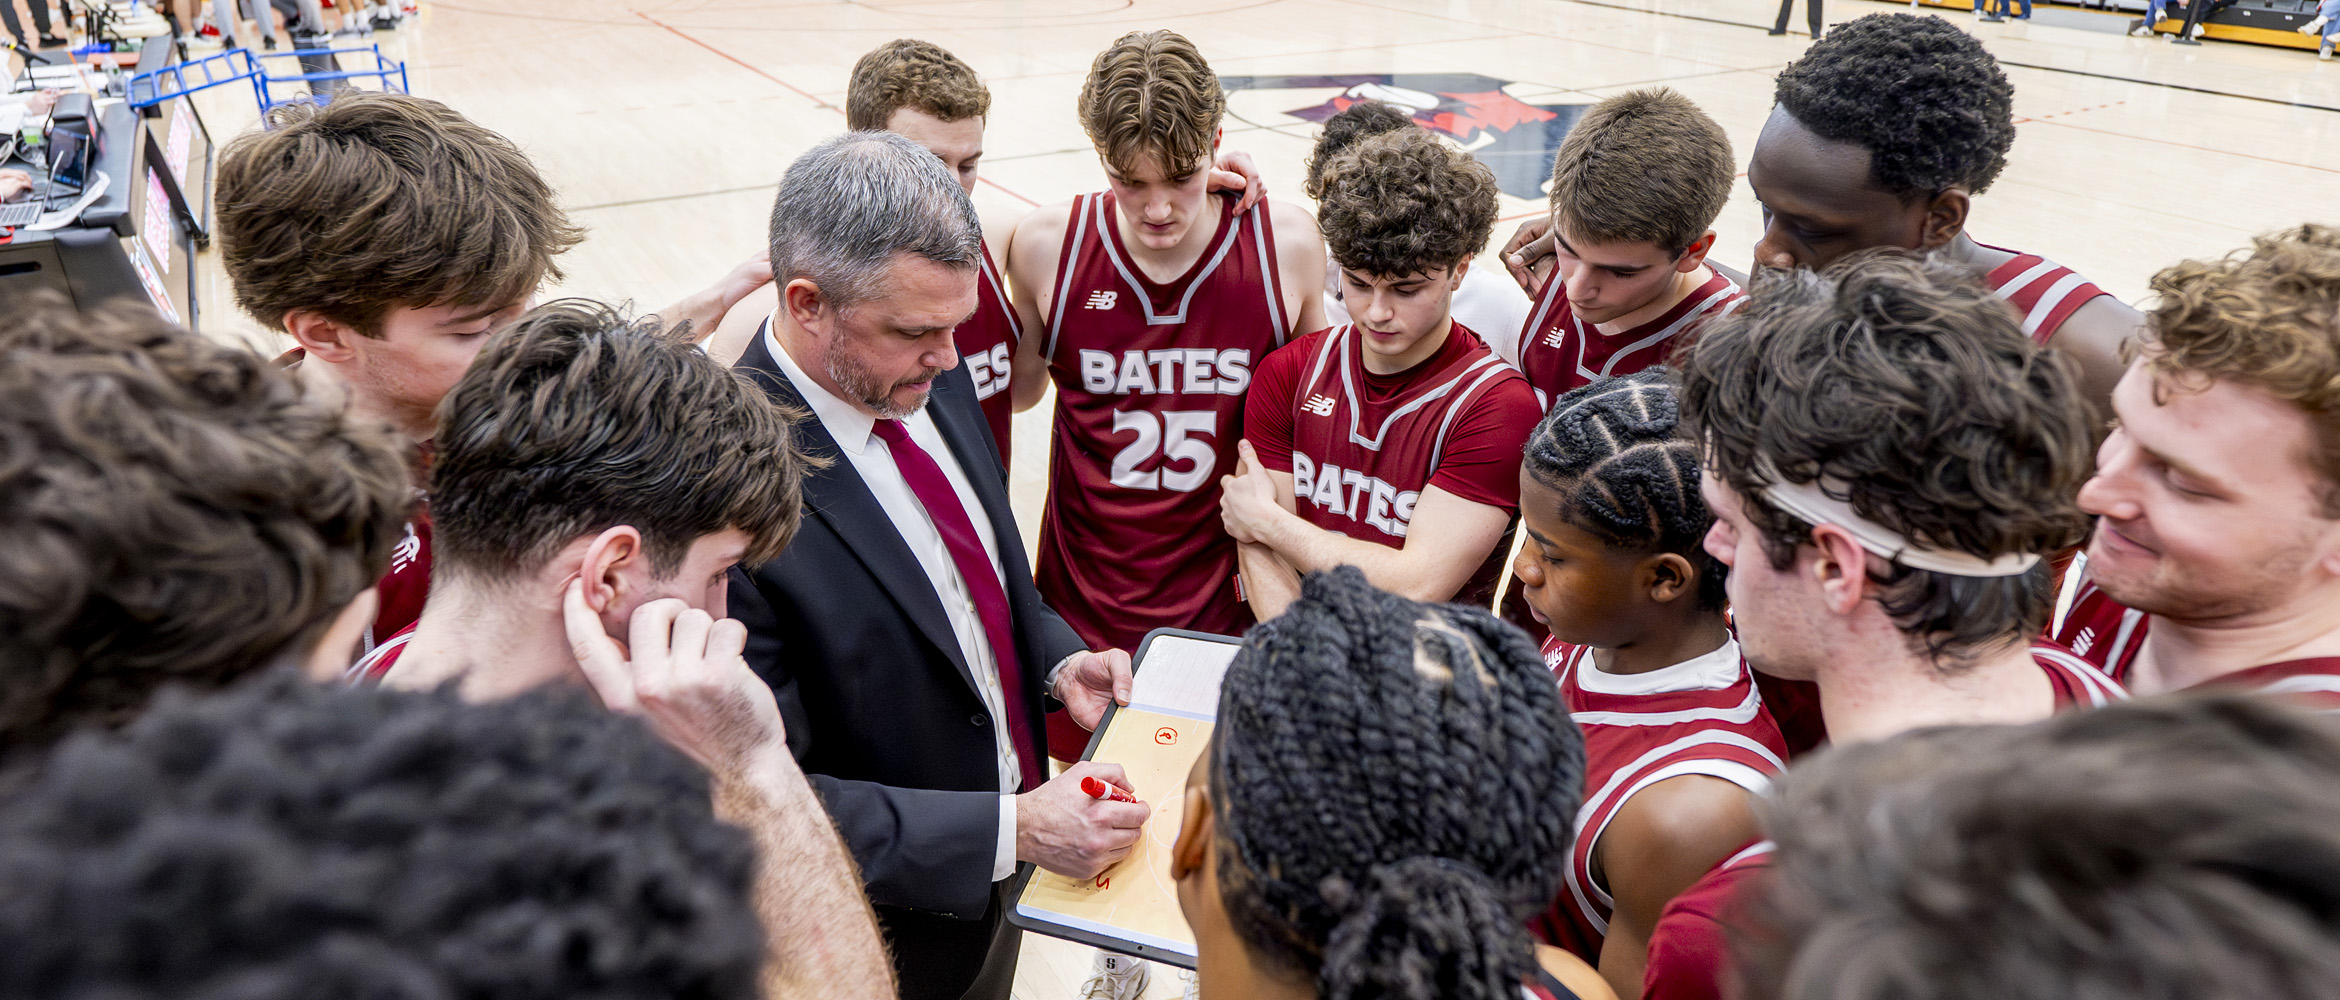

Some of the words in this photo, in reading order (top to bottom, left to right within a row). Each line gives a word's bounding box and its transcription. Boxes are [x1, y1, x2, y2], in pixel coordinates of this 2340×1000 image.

[1079, 348, 1251, 395] BATES
[1110, 408, 1217, 492] 25
[1293, 450, 1421, 537] BATES
